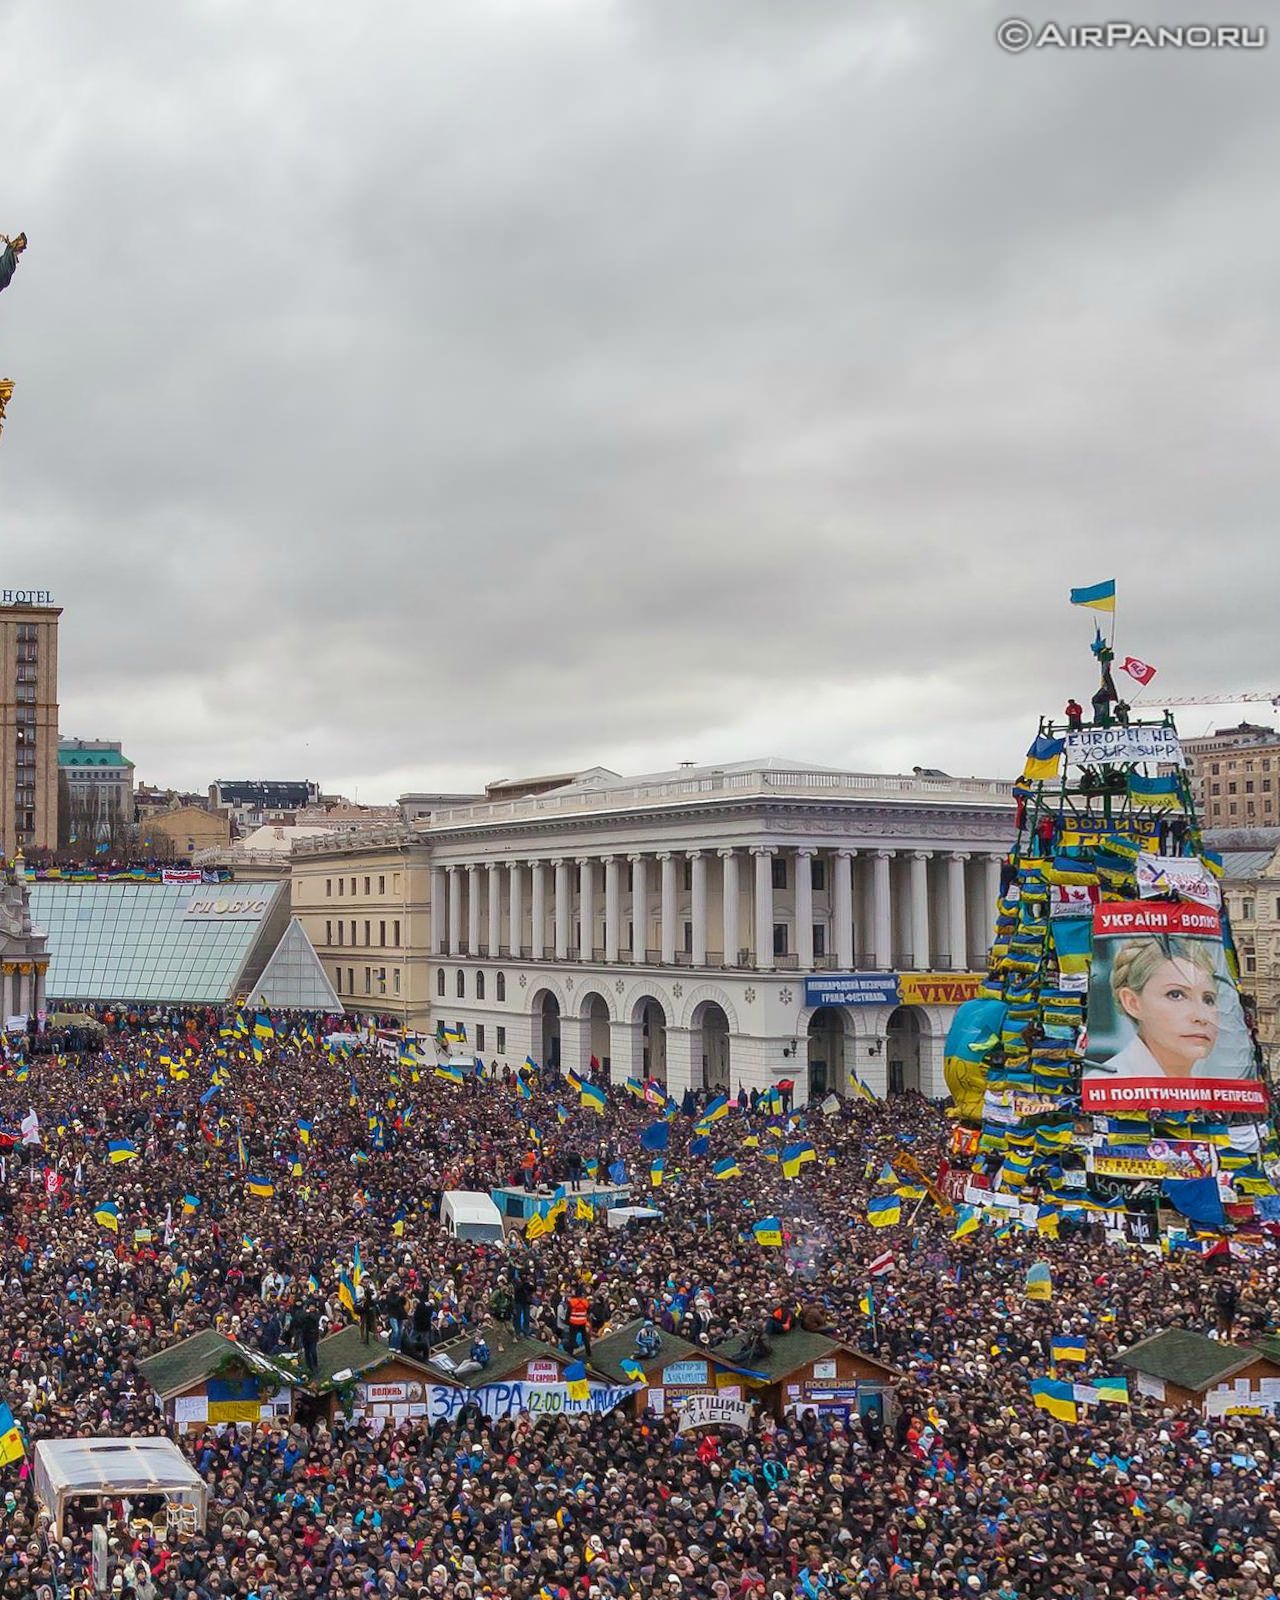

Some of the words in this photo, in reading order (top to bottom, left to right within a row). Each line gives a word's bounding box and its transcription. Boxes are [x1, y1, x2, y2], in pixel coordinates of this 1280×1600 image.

[2, 590, 54, 603] HOTEL
[1101, 911, 1168, 928] УКРАЇНІ
[1089, 1088, 1106, 1101] НІ
[1110, 1087, 1212, 1101] ПОЛІТИЧНИМ
[527, 1390, 561, 1413] 12:00
